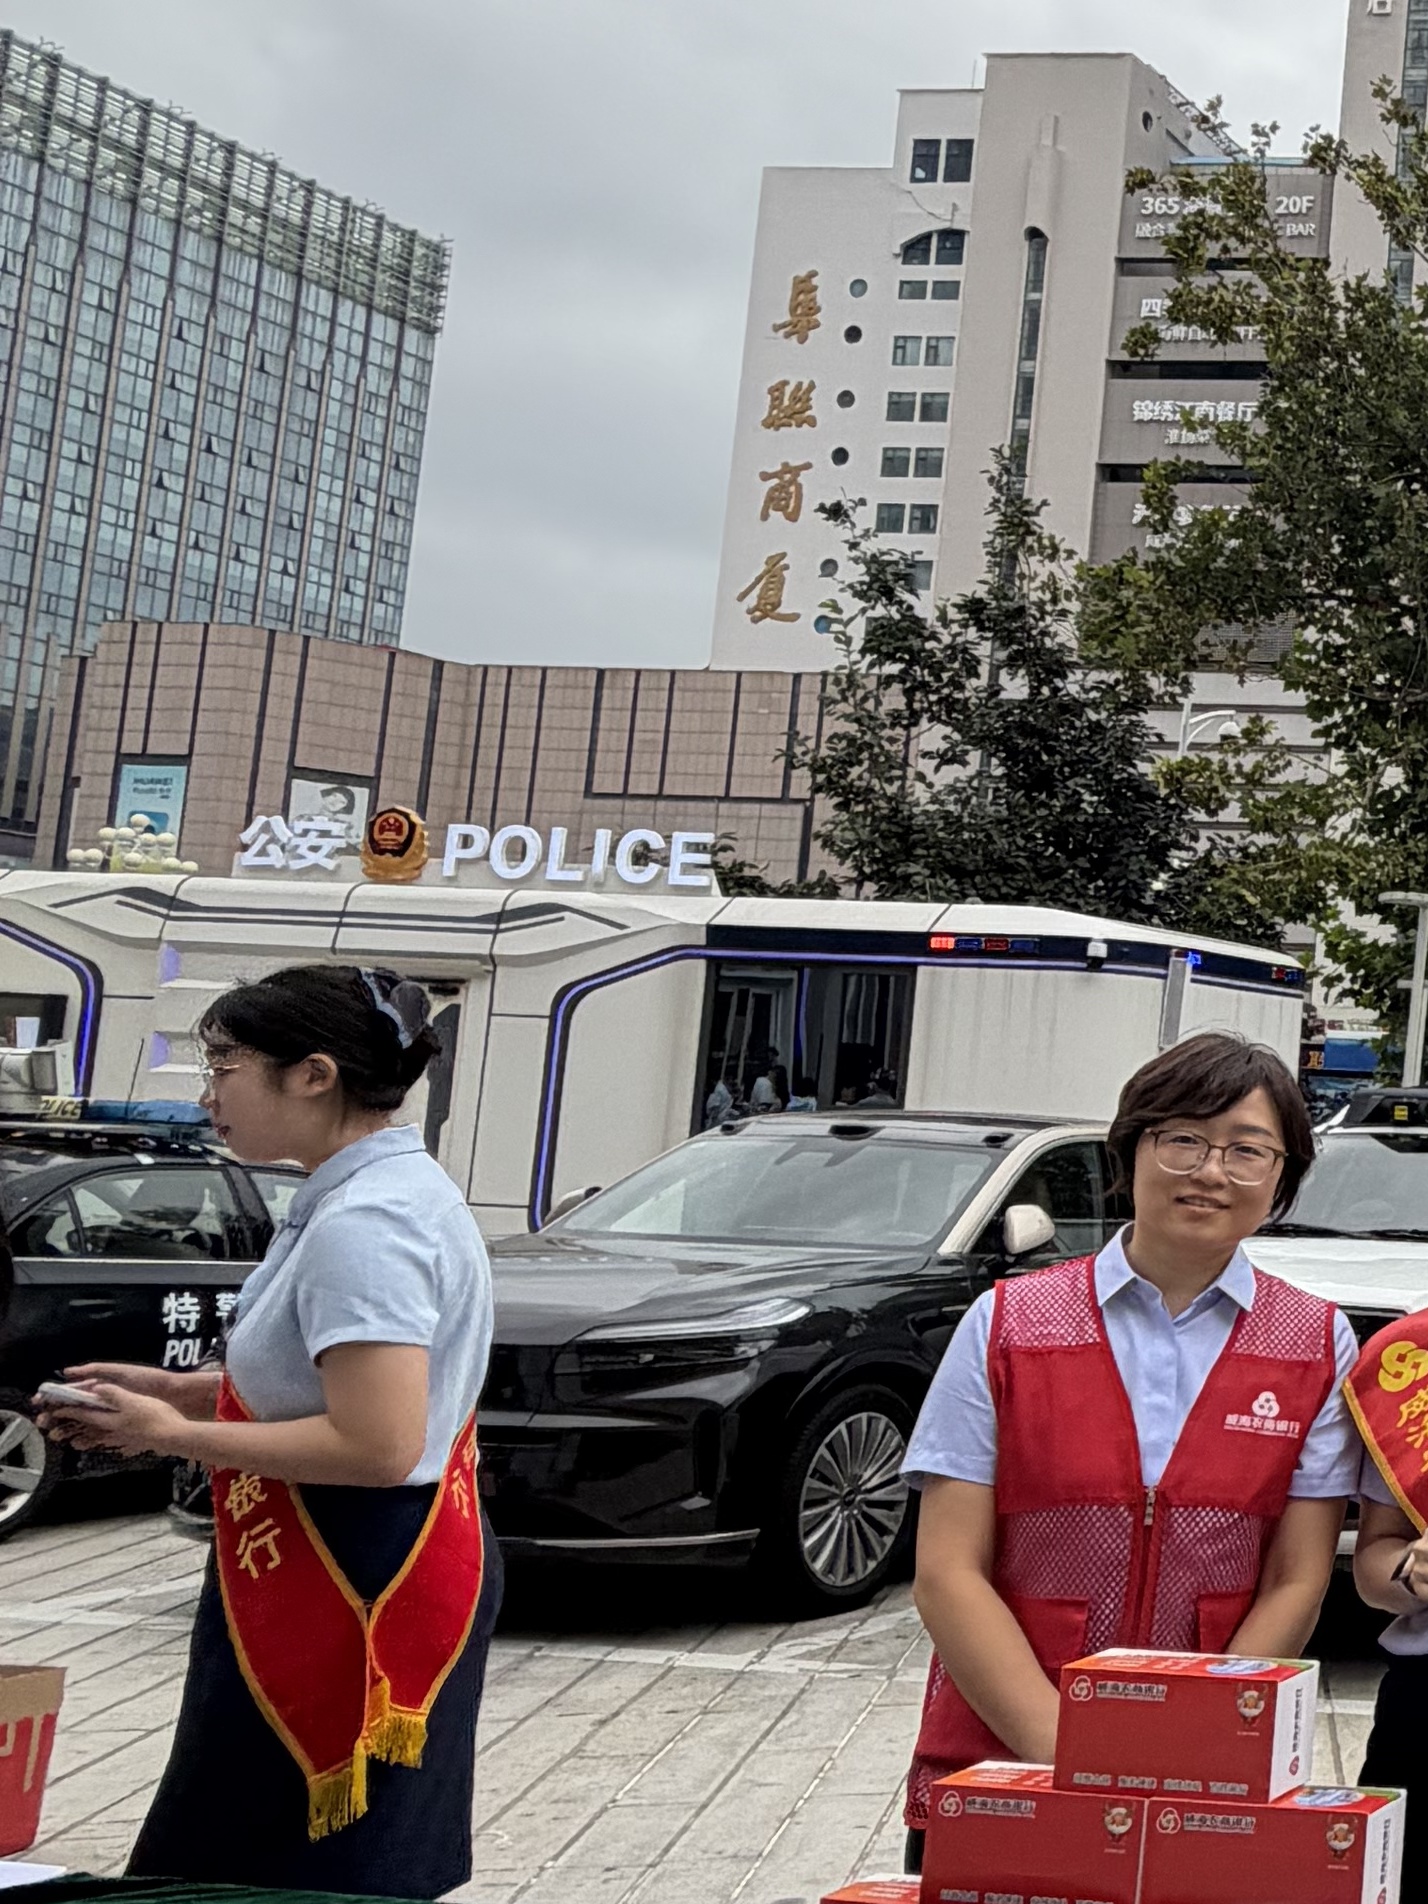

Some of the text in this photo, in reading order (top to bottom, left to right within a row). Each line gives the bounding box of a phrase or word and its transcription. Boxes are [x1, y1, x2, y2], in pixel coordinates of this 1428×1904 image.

[1275, 196, 1315, 214] 20F
[239, 815, 346, 872] 公安
[442, 823, 717, 887] POLICE
